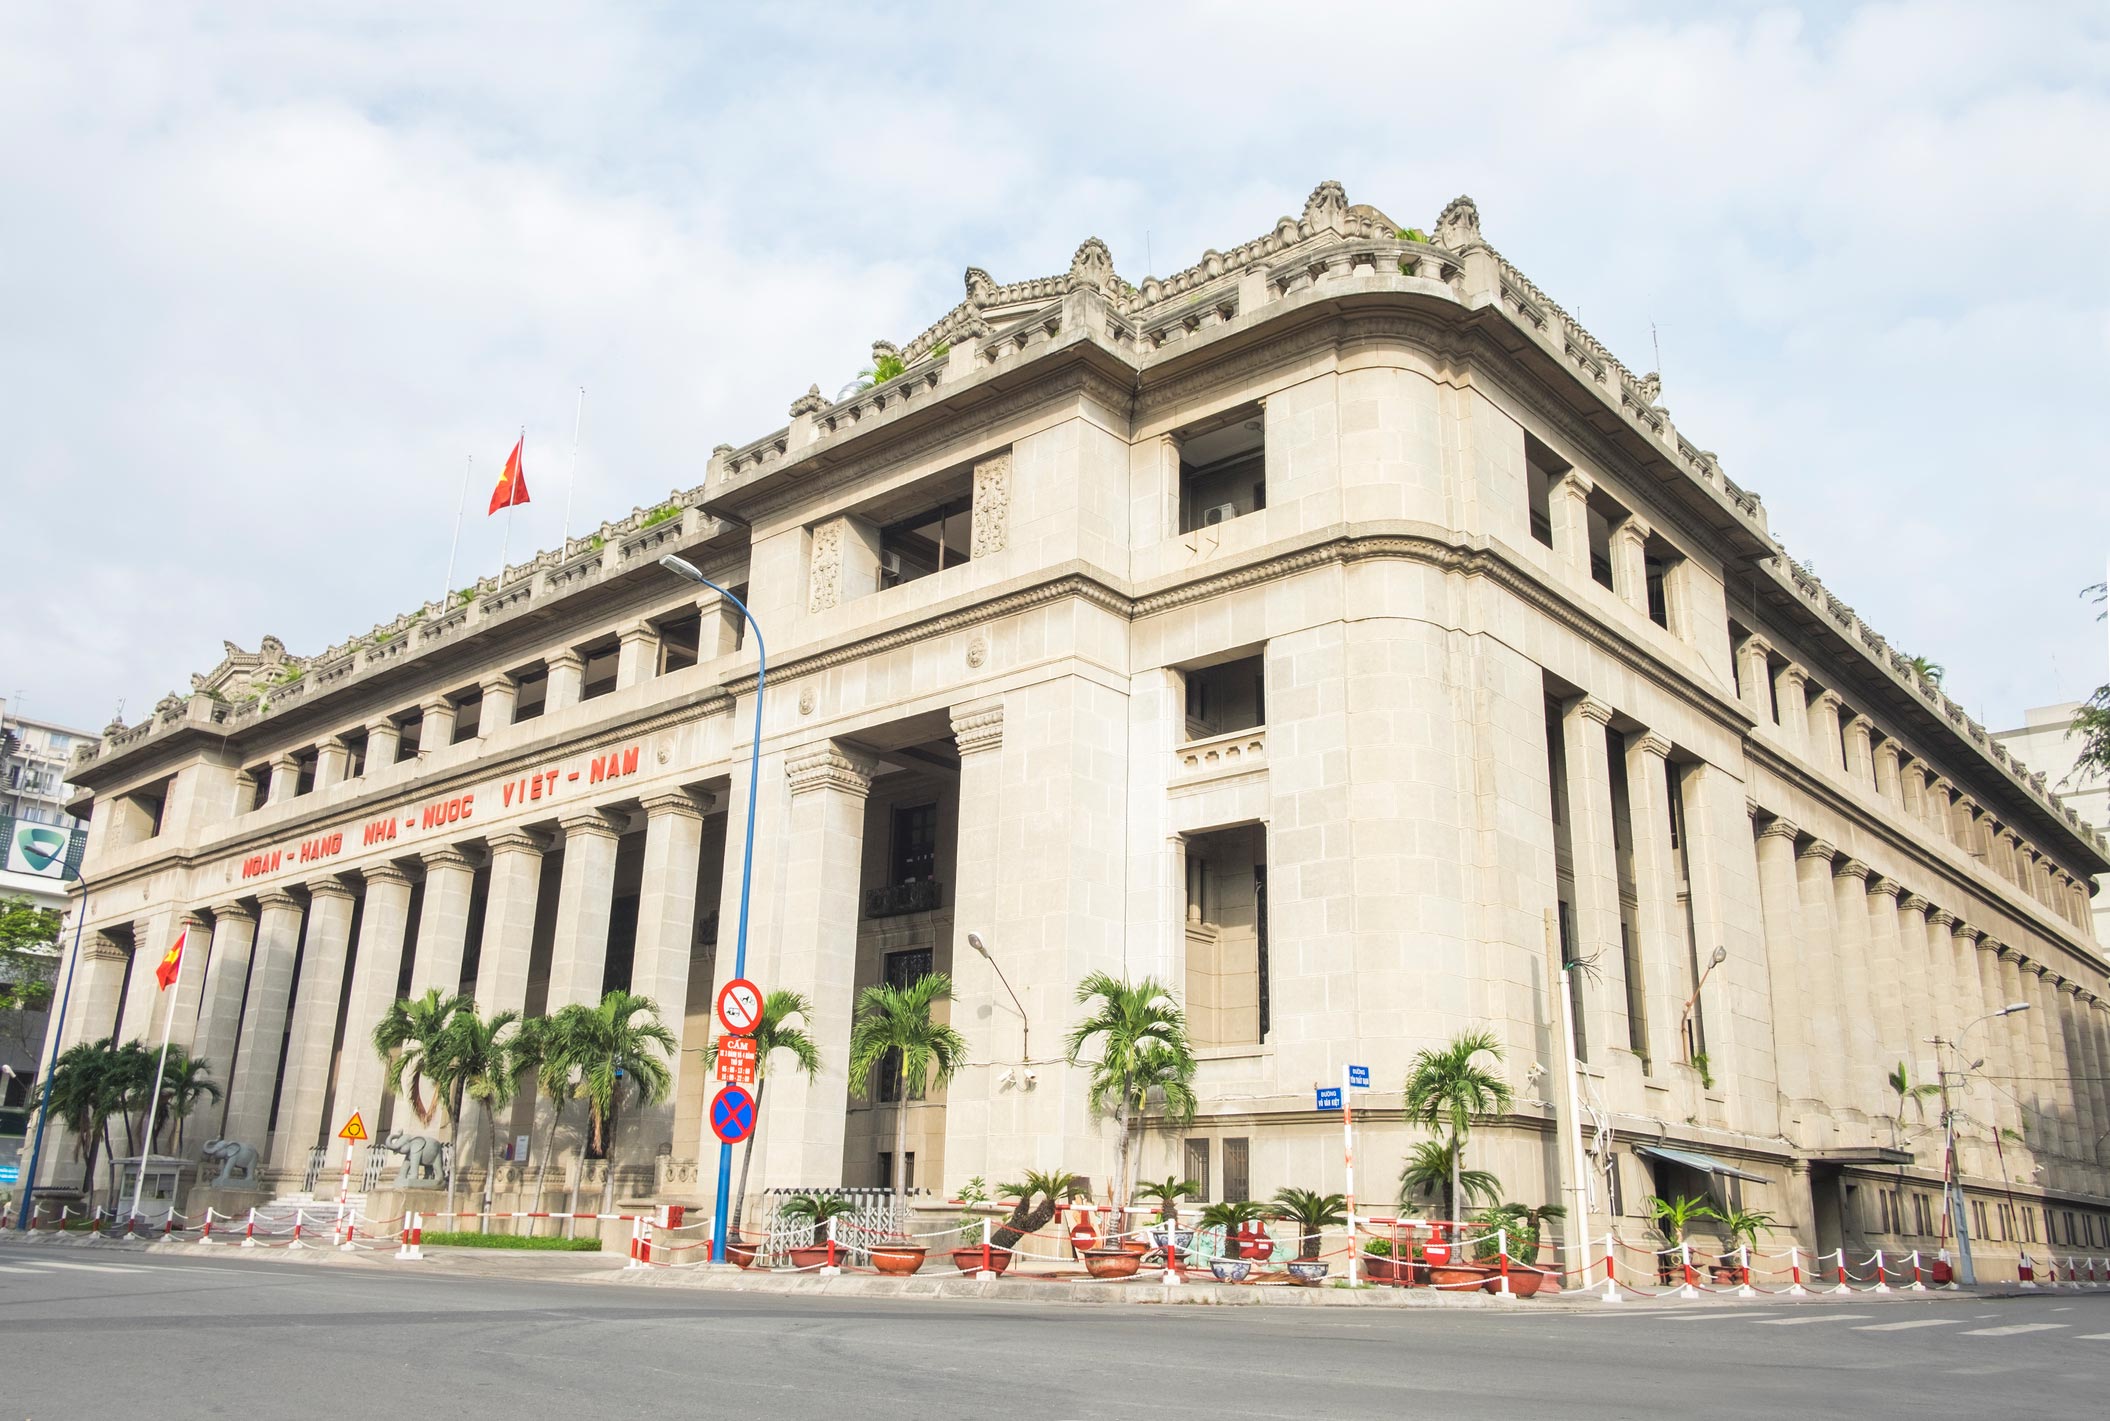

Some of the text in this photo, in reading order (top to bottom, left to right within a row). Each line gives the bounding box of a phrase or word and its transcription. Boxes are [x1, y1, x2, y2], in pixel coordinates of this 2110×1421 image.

[242, 848, 282, 879] NGAN
[300, 833, 343, 863] HANG
[363, 817, 397, 846] NHA
[422, 795, 474, 830] NUOC
[503, 769, 559, 808] VIET
[590, 747, 639, 784] NAM
[728, 1039, 748, 1050] CẤM
